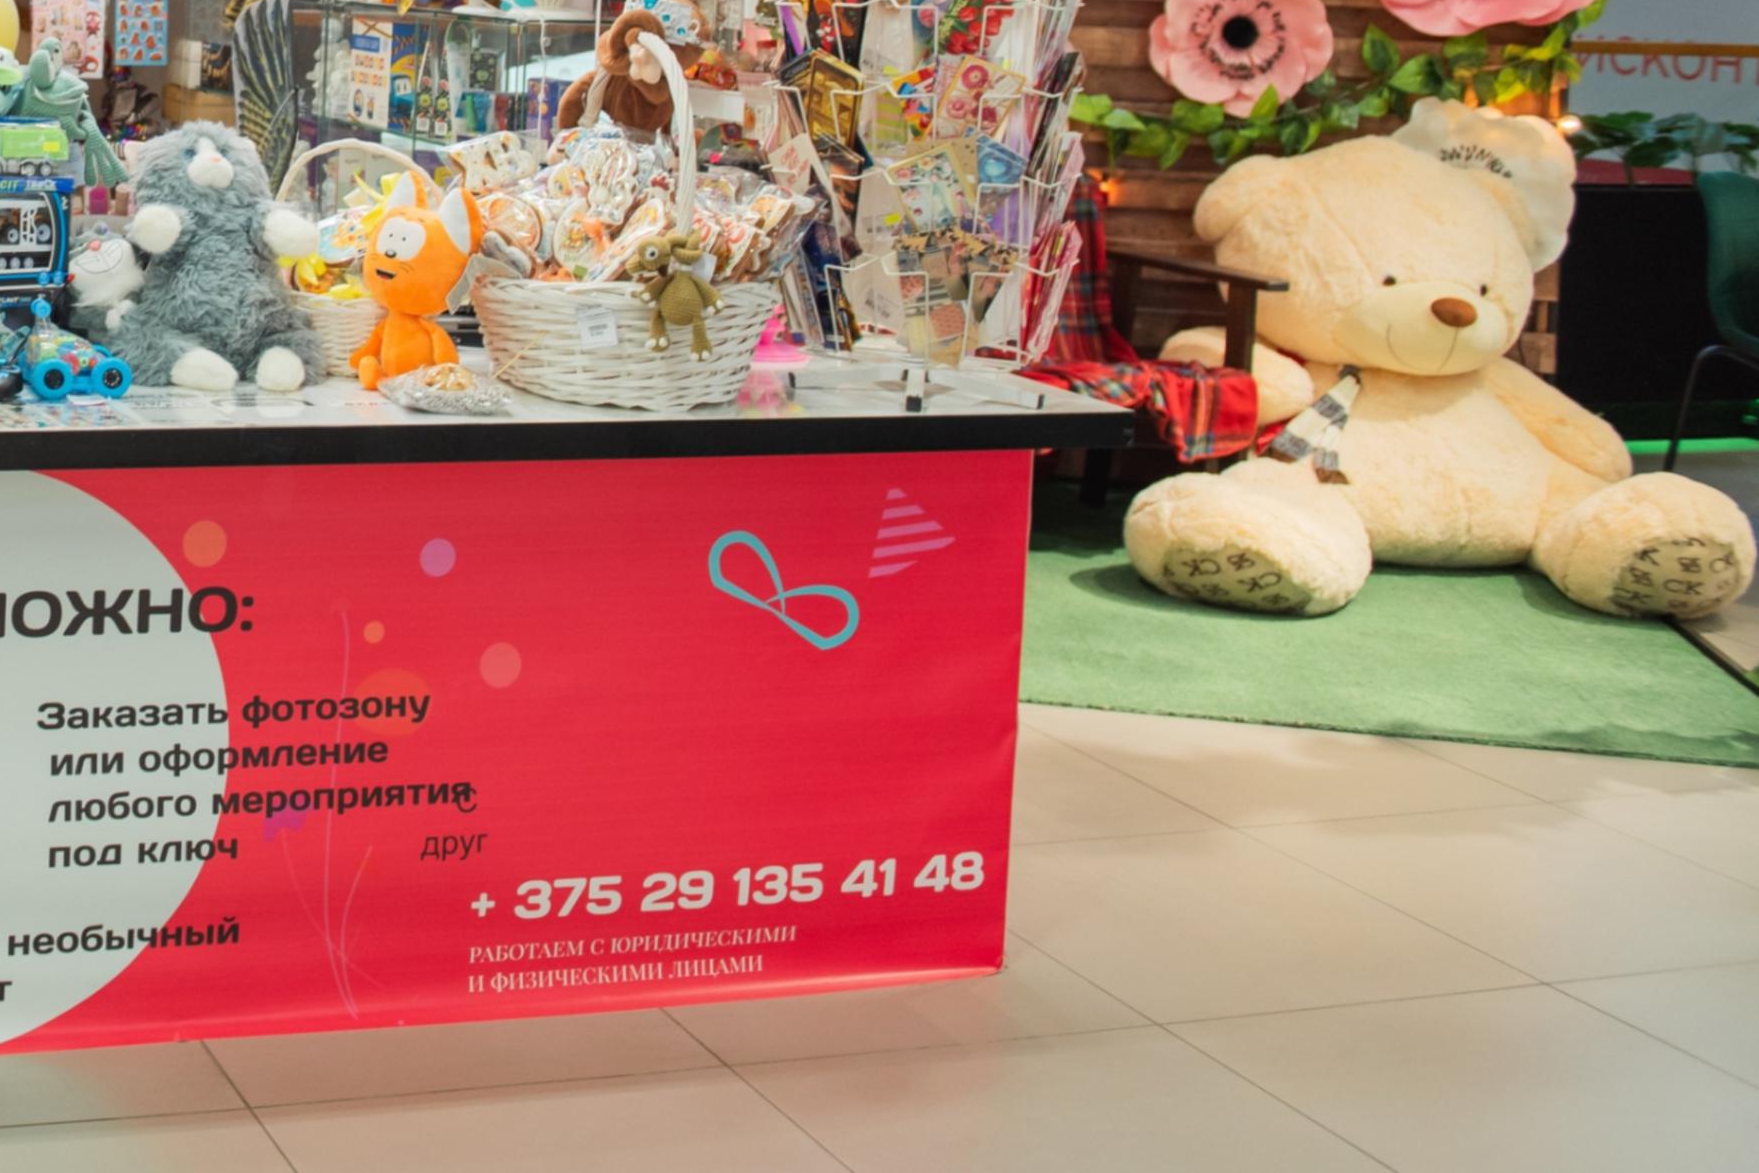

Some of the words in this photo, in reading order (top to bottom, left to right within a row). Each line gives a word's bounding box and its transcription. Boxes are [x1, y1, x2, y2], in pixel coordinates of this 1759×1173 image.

[37, 703, 228, 730] Заказать
[243, 696, 429, 728] фотозону
[51, 752, 123, 776] или
[139, 743, 387, 777] оформление
[49, 792, 196, 822] любого
[212, 783, 472, 818] мероприятия
[49, 844, 121, 868] под
[138, 840, 237, 863] ключ
[420, 833, 488, 861] друг
[472, 893, 495, 916] +
[515, 876, 621, 918] 375
[641, 871, 714, 911] 29
[734, 863, 822, 905] 135
[841, 859, 895, 897] 41
[914, 852, 983, 891] 48
[8, 918, 239, 956] необычный
[469, 939, 584, 964] РАБОТАЕМ
[591, 939, 604, 956] С
[610, 926, 797, 955] ЮРИДИЧЕСКИМИ
[469, 974, 485, 994] И
[490, 960, 663, 993] ФИЗИЧЕСКИМИ
[669, 954, 763, 979] ЛИЦАМИ
